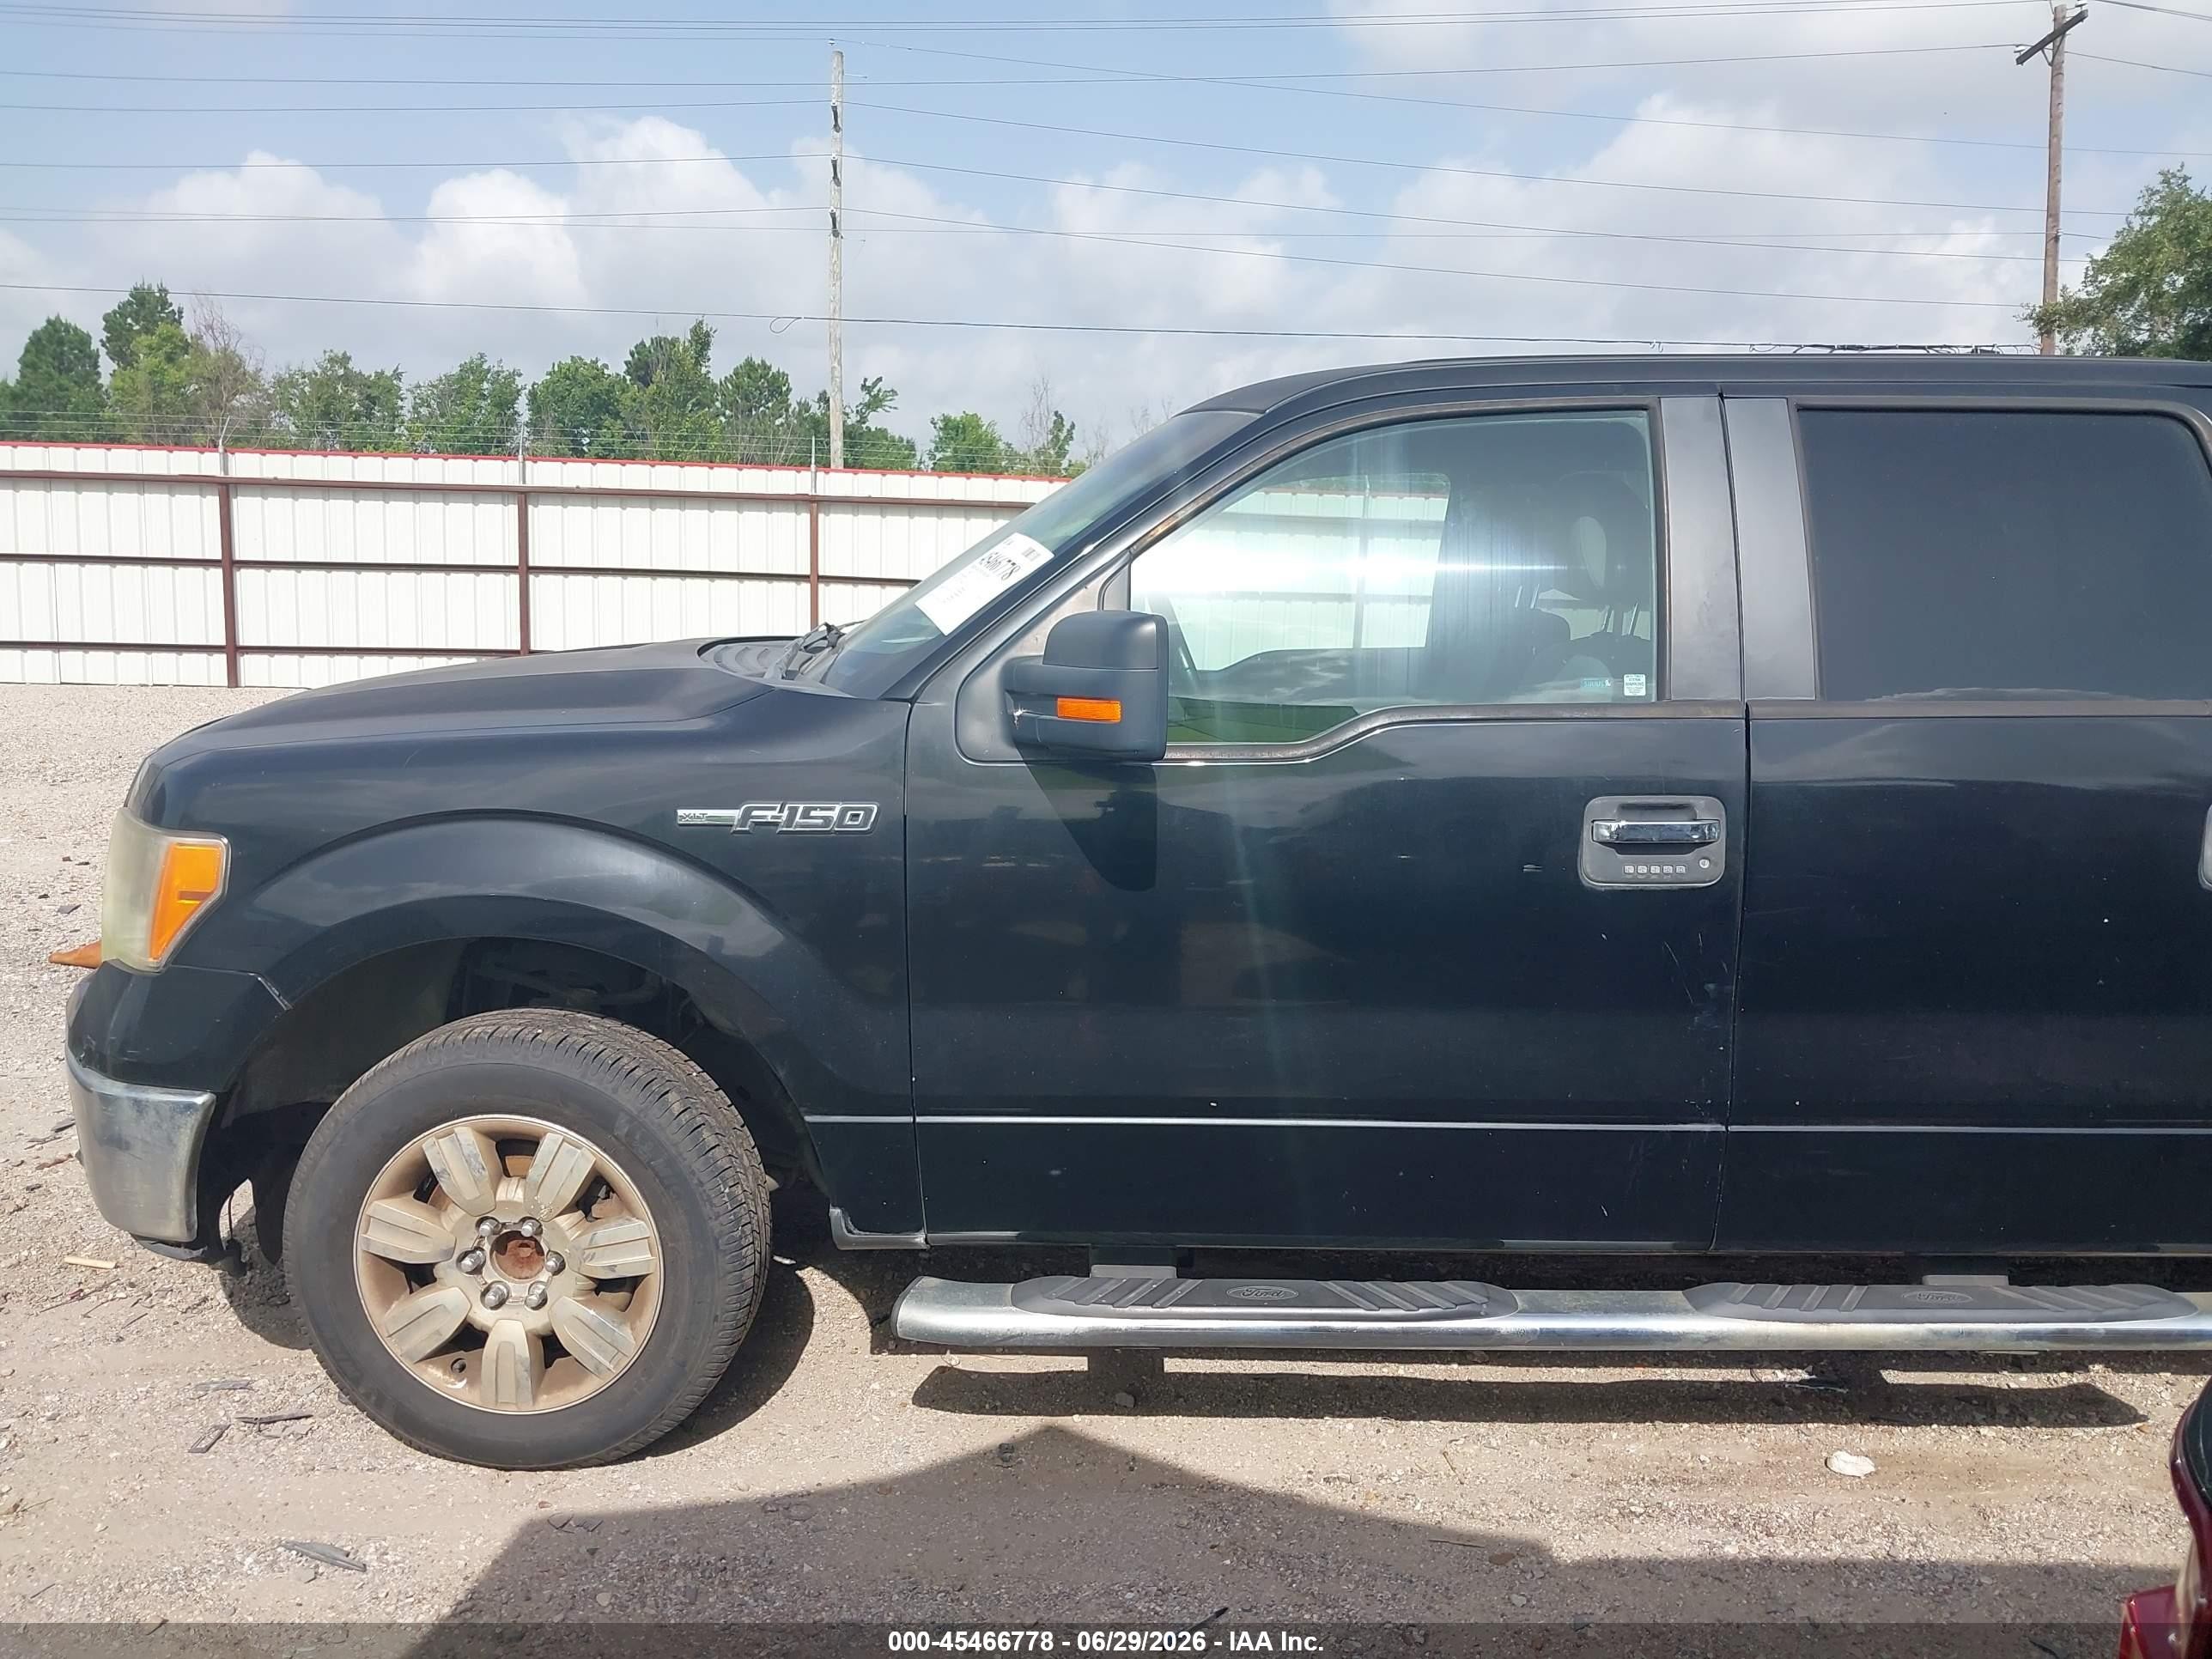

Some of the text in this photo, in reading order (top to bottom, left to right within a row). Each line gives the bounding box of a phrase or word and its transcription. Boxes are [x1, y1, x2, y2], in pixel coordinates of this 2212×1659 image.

[681, 801, 879, 835] XLT F-150
[1241, 1286, 1285, 1298] Ford
